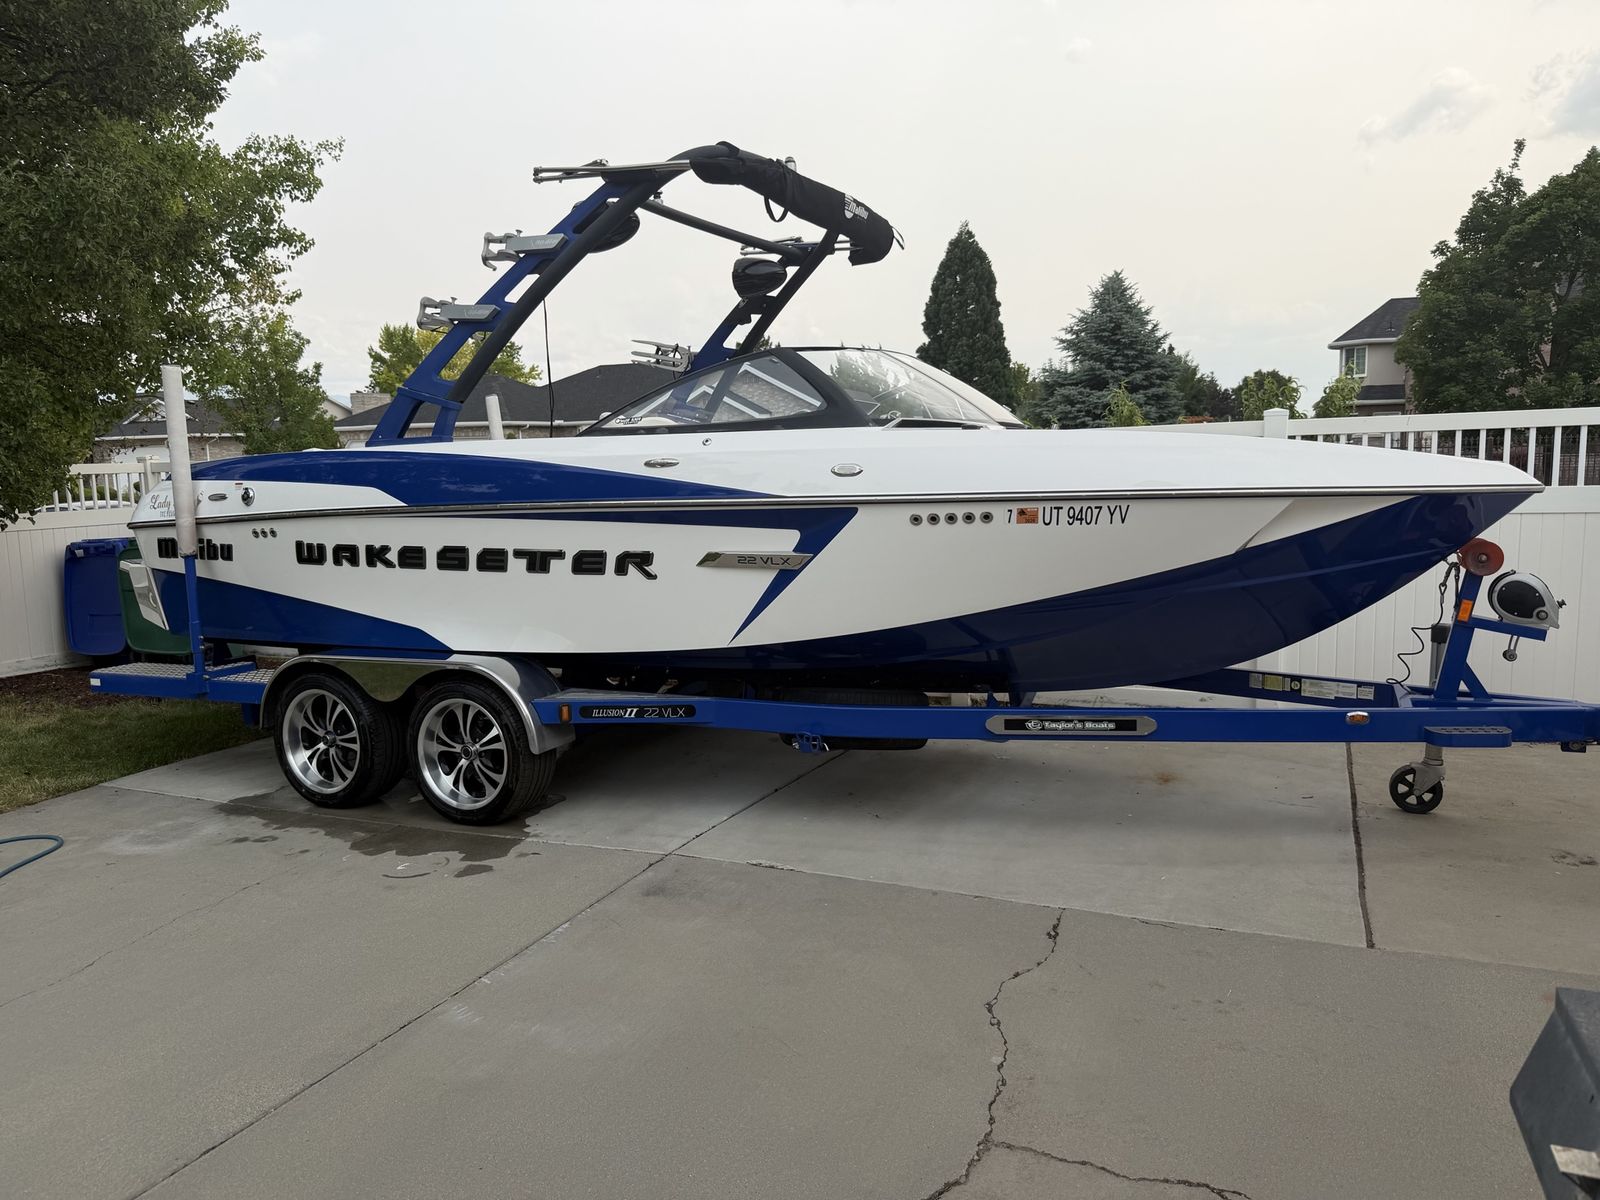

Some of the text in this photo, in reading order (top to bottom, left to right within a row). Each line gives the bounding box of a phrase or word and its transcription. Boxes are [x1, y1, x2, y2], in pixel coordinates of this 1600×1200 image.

[150, 494, 171, 512] Lady
[1042, 506, 1063, 526] UT
[1067, 505, 1102, 526] 9407
[1107, 504, 1130, 525] YV
[157, 537, 233, 561] Mibu
[295, 540, 658, 580] WAKESETTER
[737, 556, 791, 566] 22 VLX
[643, 707, 660, 718] 22
[662, 707, 686, 718] VLX
